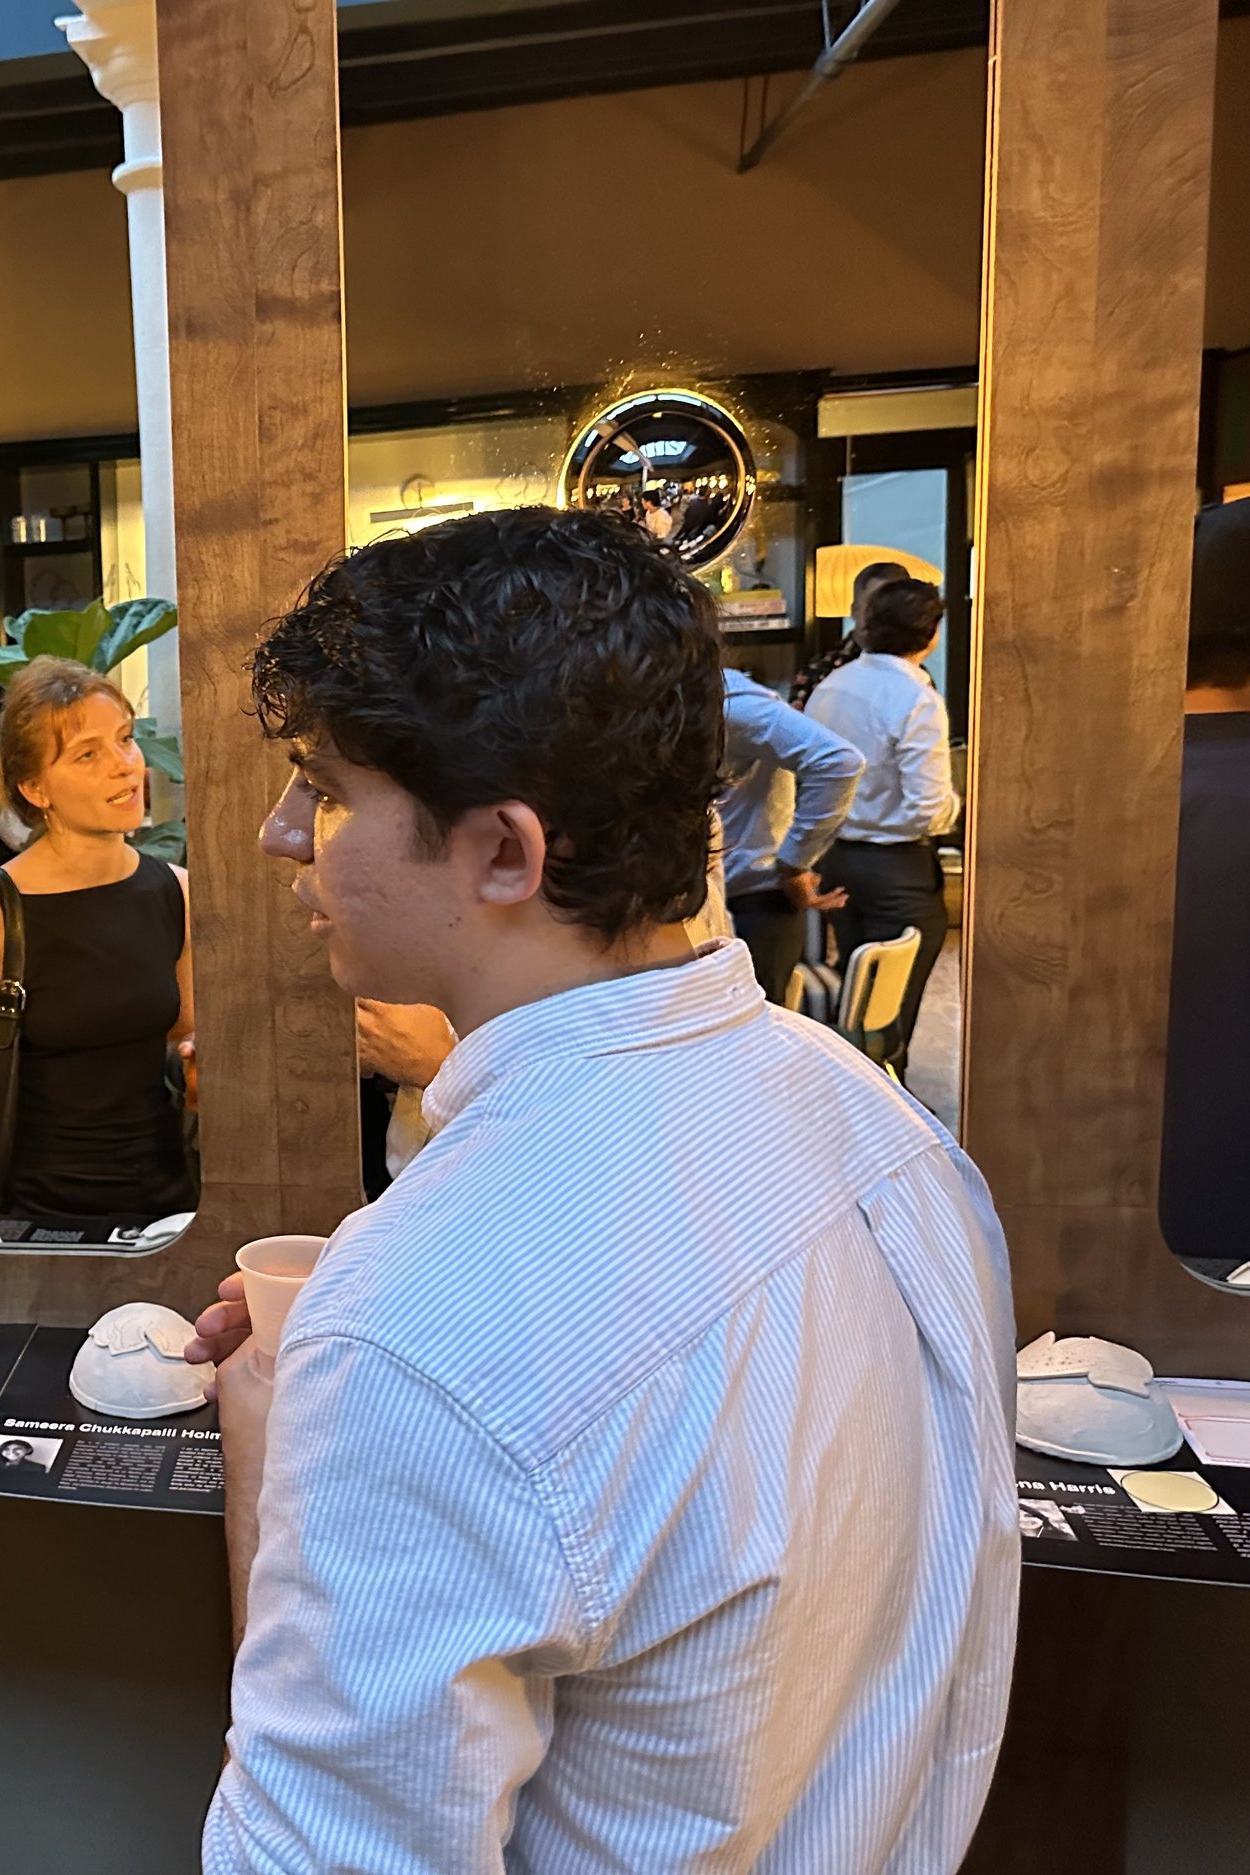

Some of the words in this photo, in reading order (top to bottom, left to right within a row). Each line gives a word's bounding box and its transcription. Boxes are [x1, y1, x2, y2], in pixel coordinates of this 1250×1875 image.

[3, 1418, 76, 1432] Sameera
[79, 1423, 178, 1438] Chukkapalli
[1048, 1481, 1116, 1495] Harris
